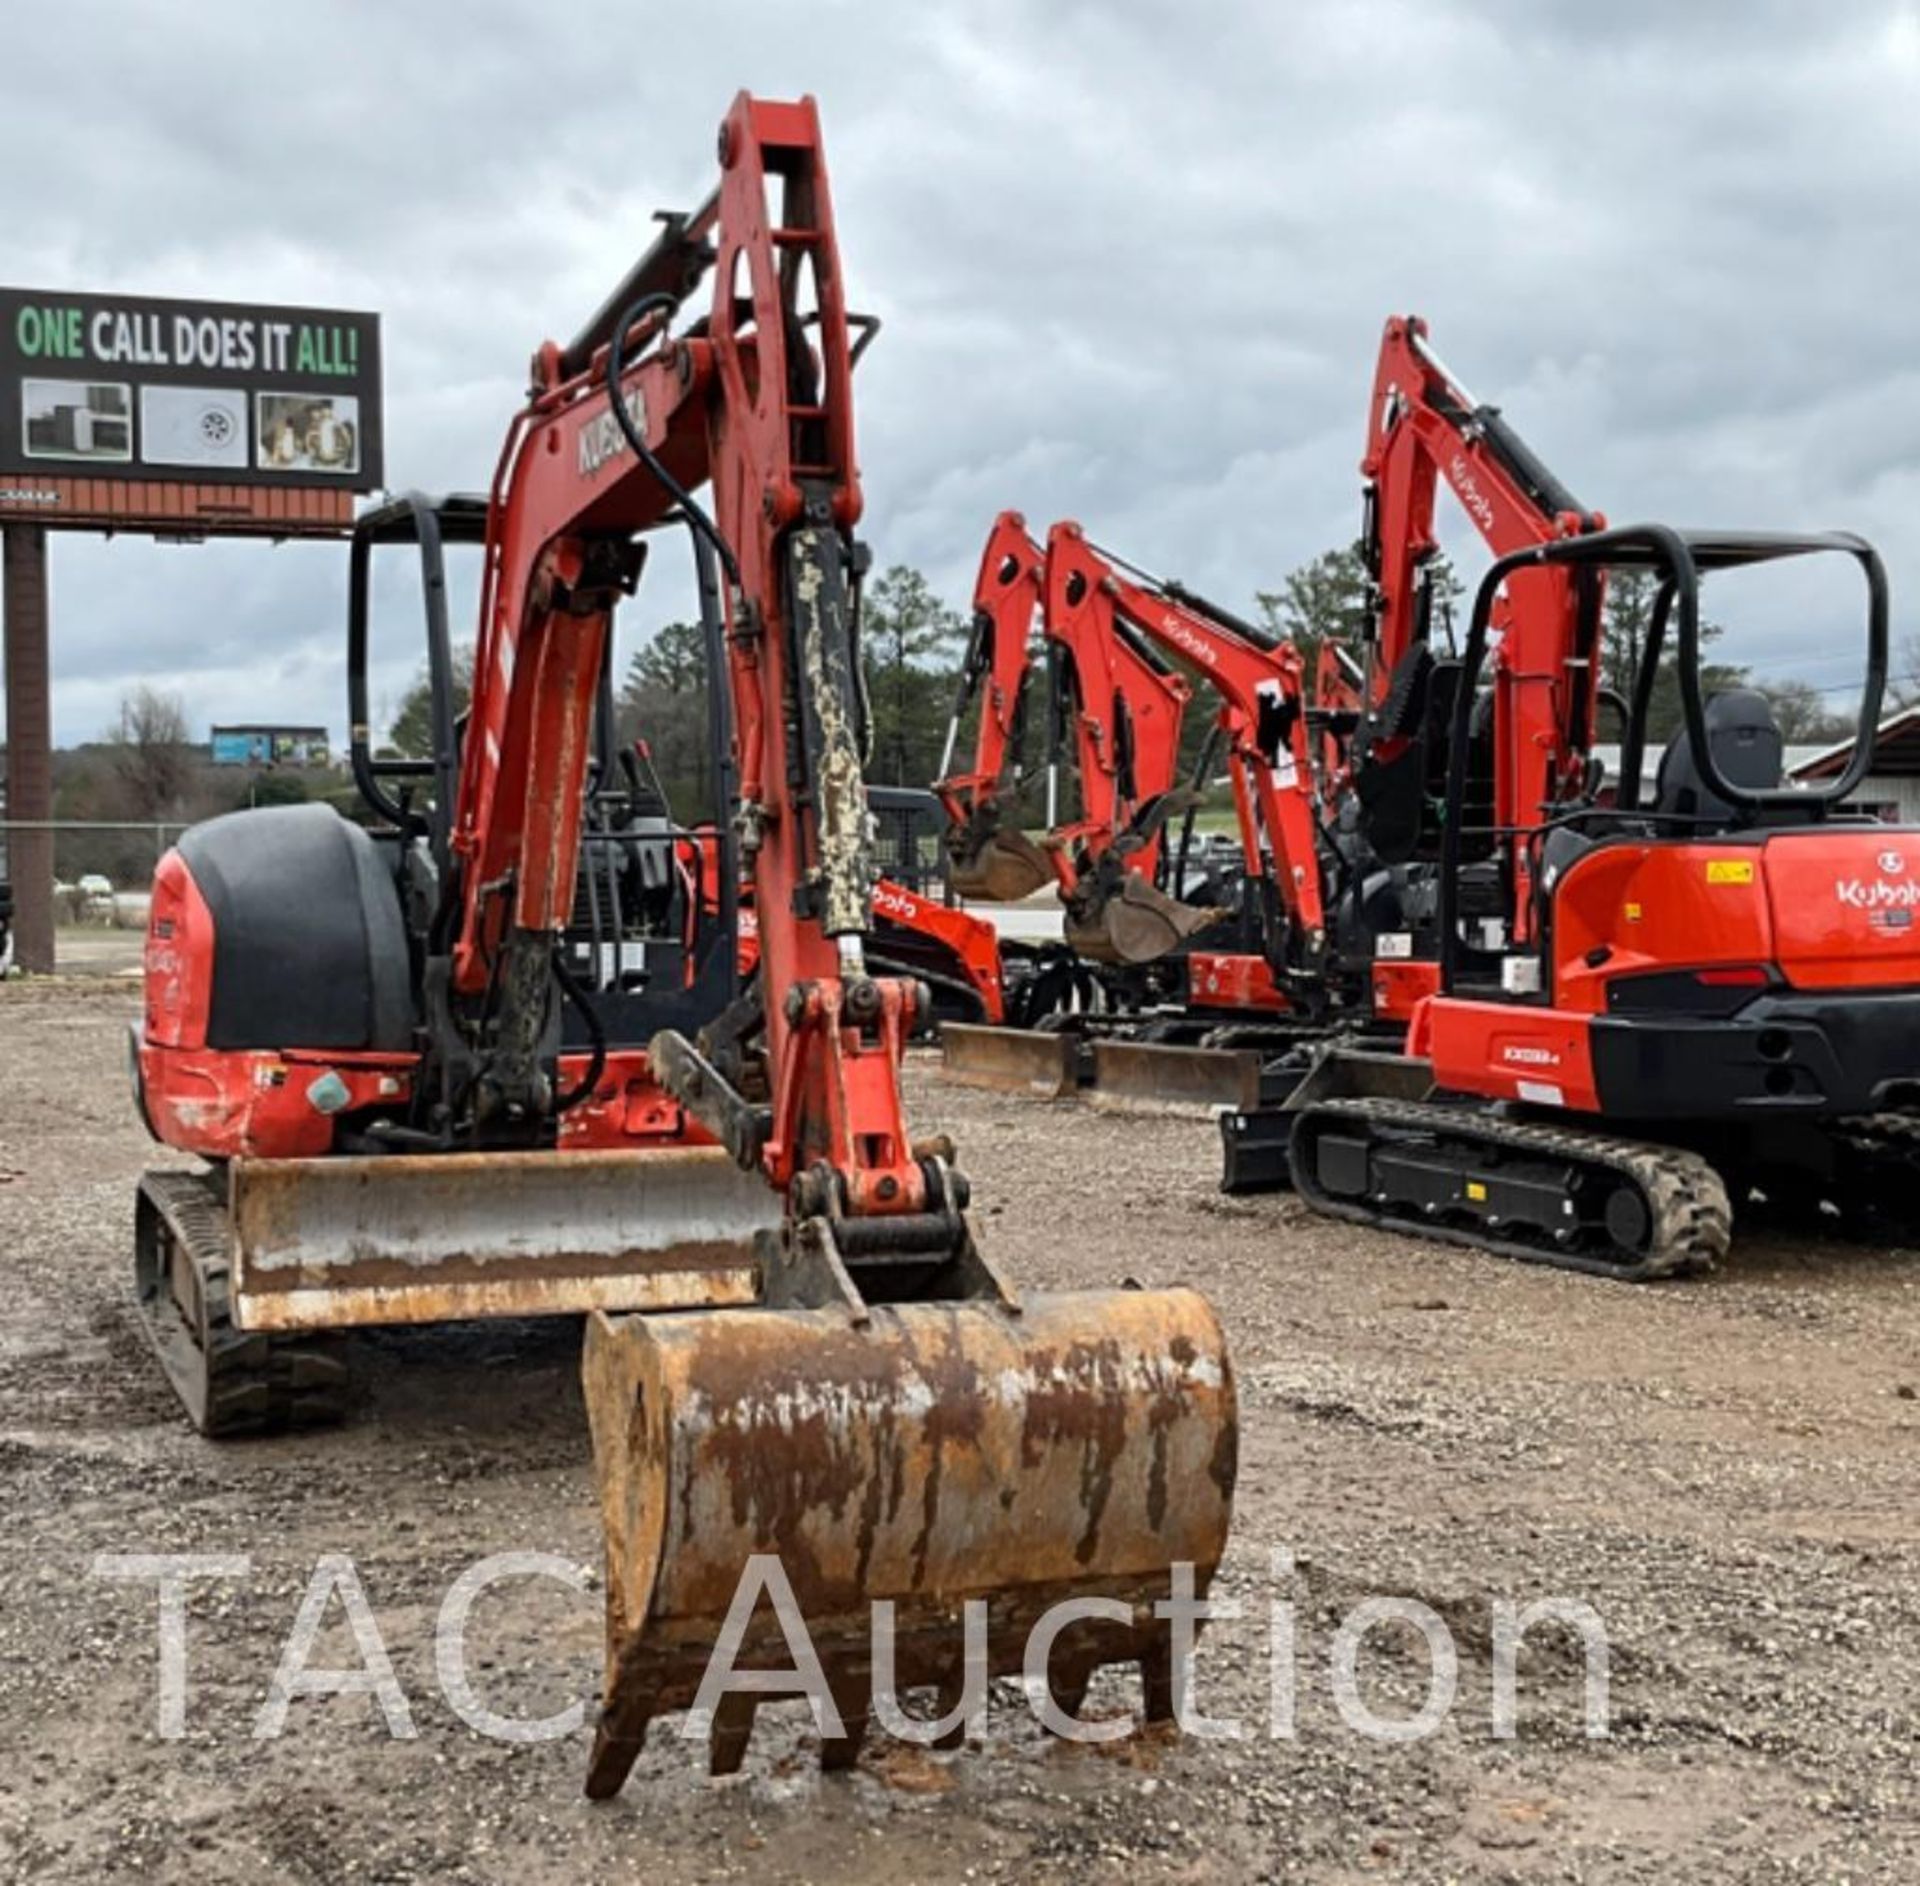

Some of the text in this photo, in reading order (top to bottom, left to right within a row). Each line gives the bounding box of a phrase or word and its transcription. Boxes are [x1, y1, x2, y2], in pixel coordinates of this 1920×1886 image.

[17, 306, 358, 375] ONE CALL DOES IT ALL!
[1835, 878, 1920, 907] Kubot
